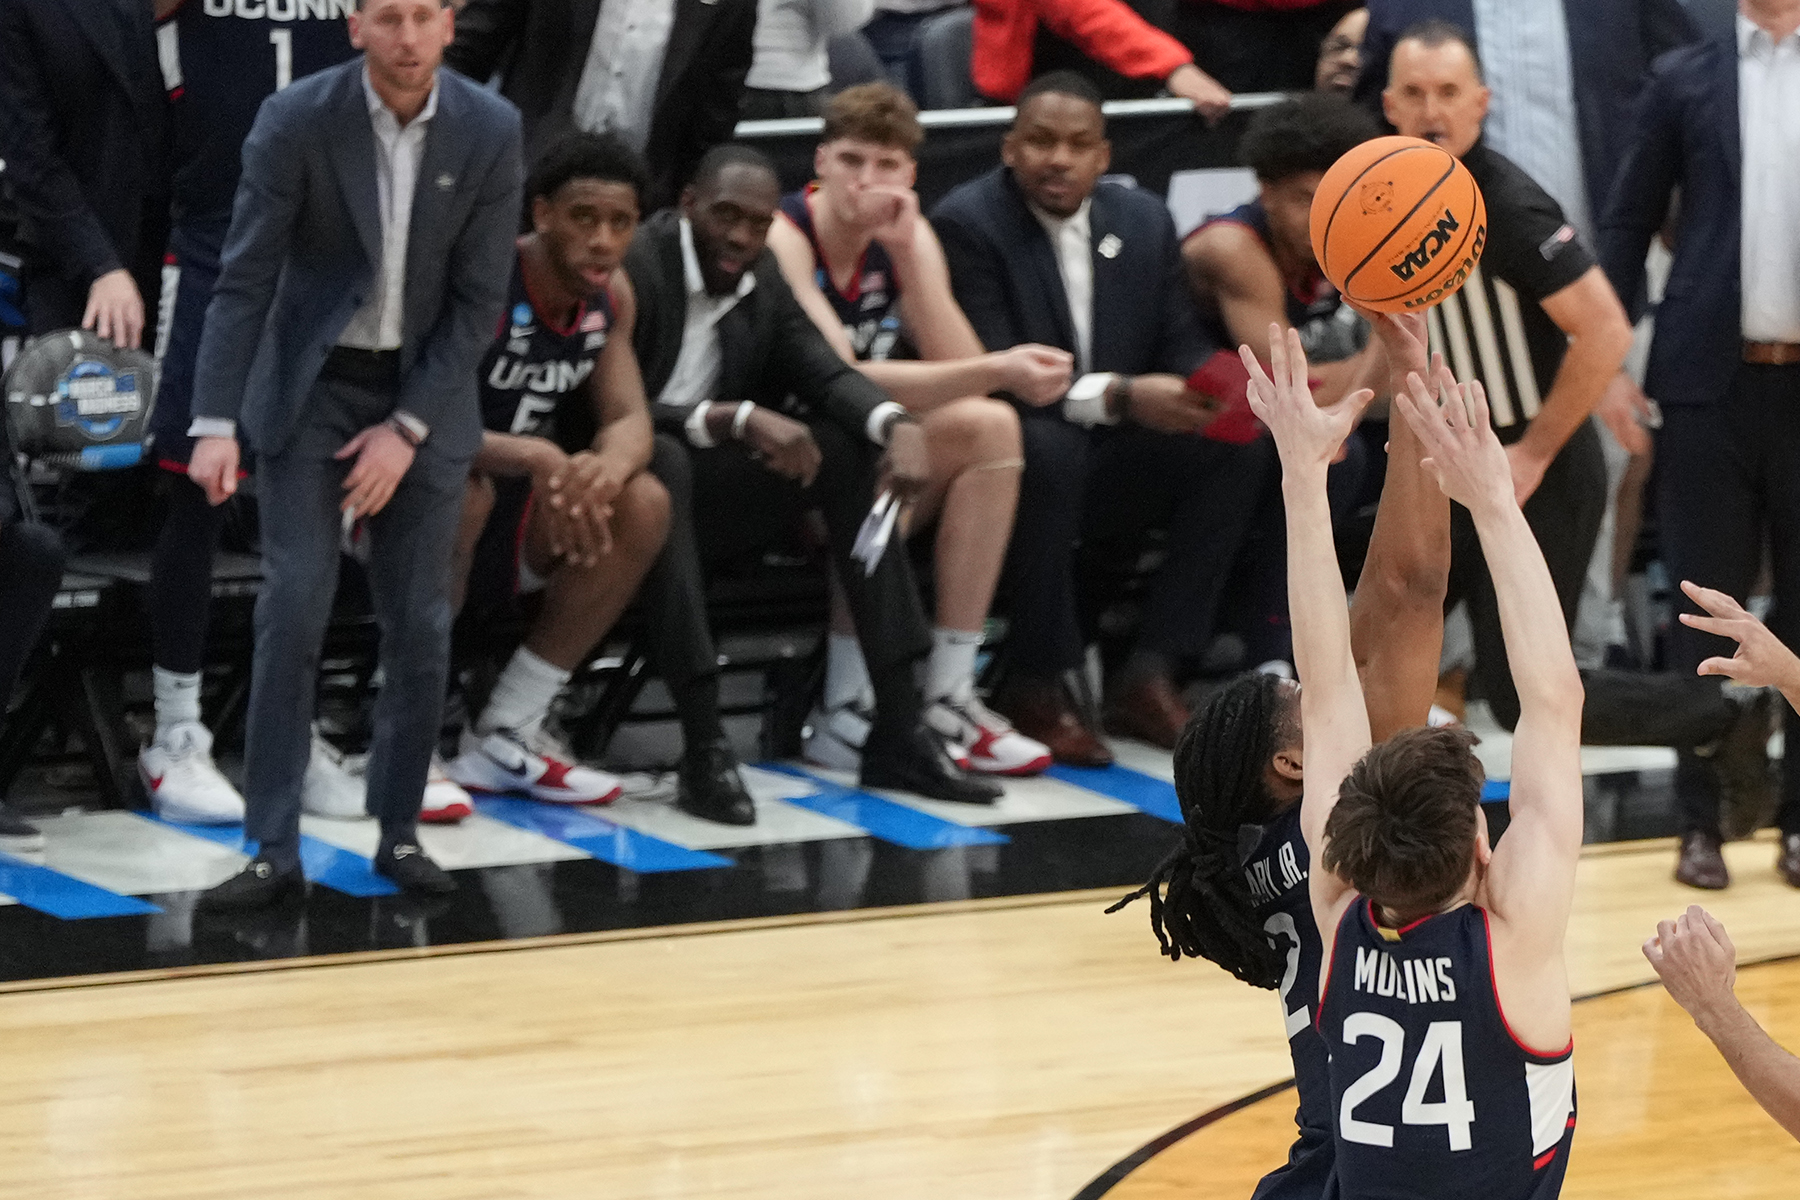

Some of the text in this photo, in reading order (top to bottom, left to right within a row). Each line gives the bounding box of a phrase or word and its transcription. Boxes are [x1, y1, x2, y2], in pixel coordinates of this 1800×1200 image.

[269, 29, 292, 92] 1
[1390, 208, 1460, 283] NCAA
[1278, 840, 1308, 890] JR.
[1340, 1011, 1476, 1152] 24
